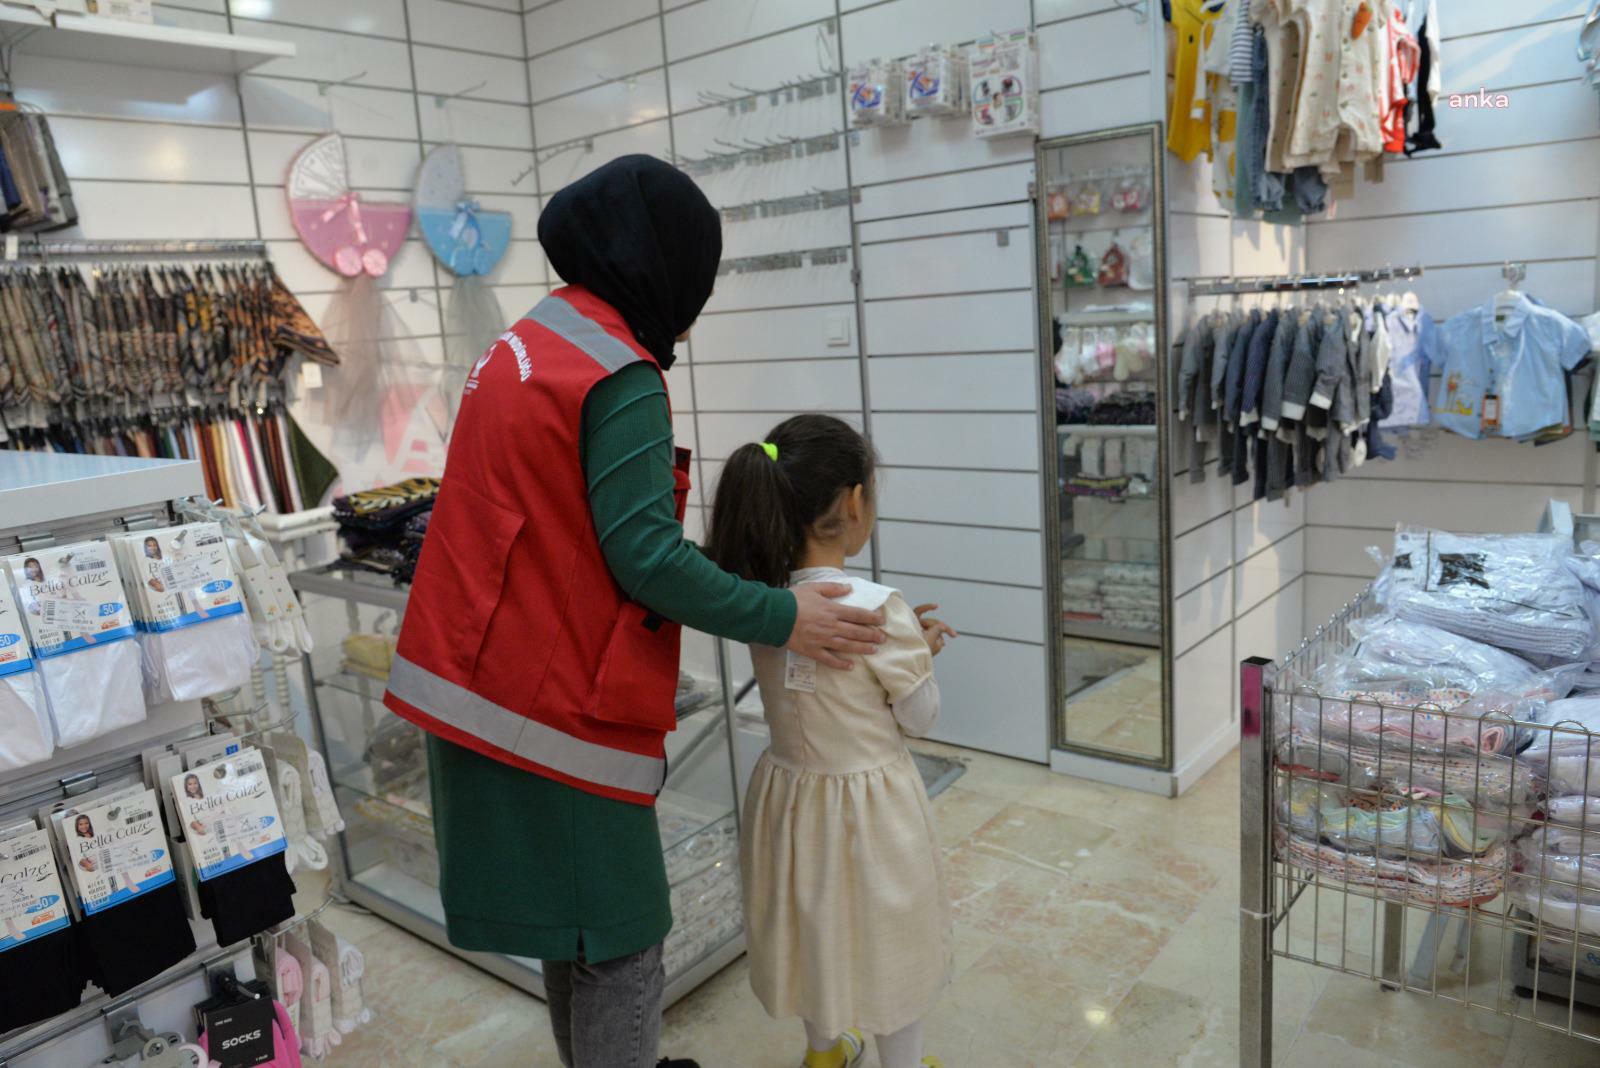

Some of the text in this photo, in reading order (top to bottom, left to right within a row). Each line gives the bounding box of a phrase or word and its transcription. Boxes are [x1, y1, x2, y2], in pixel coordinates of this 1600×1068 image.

[30, 571, 106, 597] Bella Calze
[103, 603, 114, 615] 50
[191, 797, 222, 815] Bella
[79, 822, 149, 853] Bella Calze
[222, 1029, 261, 1050] SOCKS
